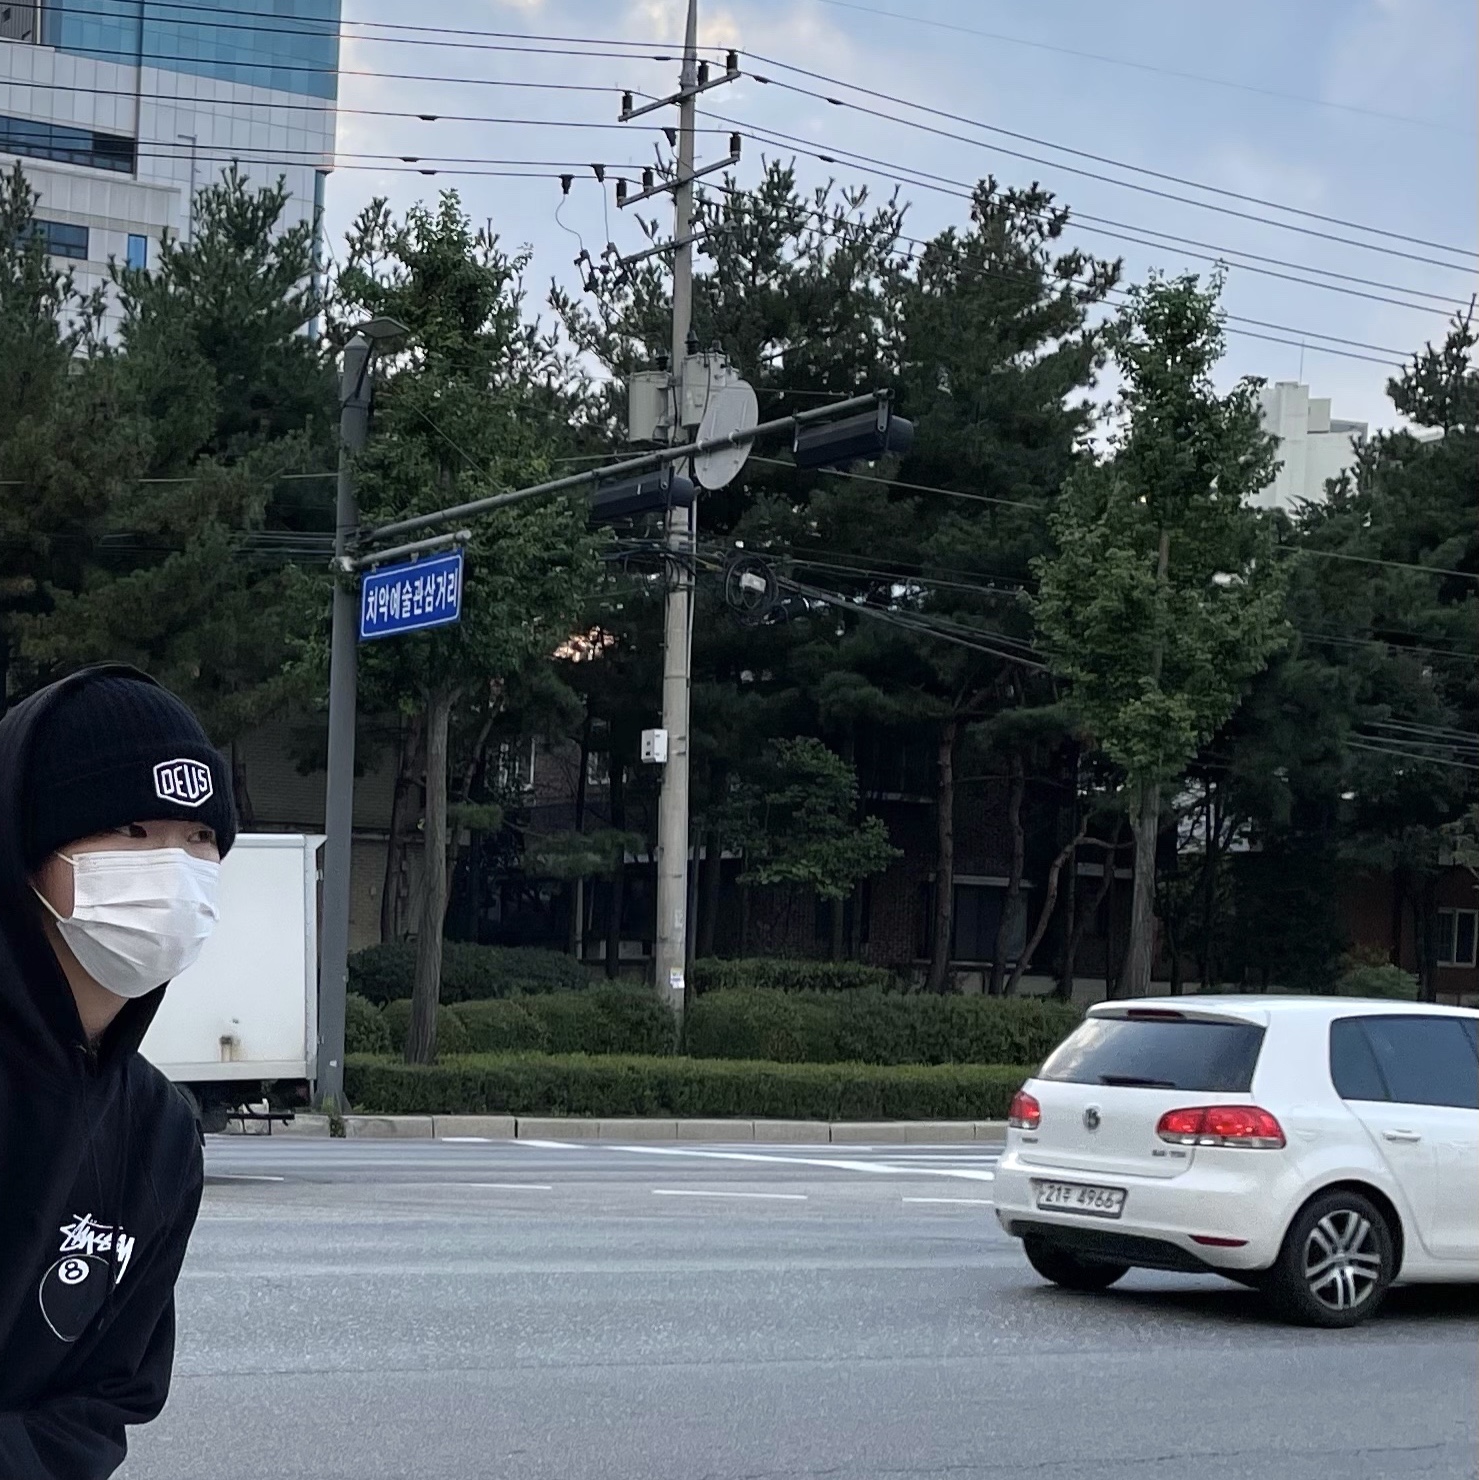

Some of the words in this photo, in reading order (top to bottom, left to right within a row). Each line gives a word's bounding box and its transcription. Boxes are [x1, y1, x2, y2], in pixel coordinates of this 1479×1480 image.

[366, 567, 459, 625] 치악예술관삼거리
[160, 763, 208, 799] DEUS
[64, 1260, 83, 1281] 8
